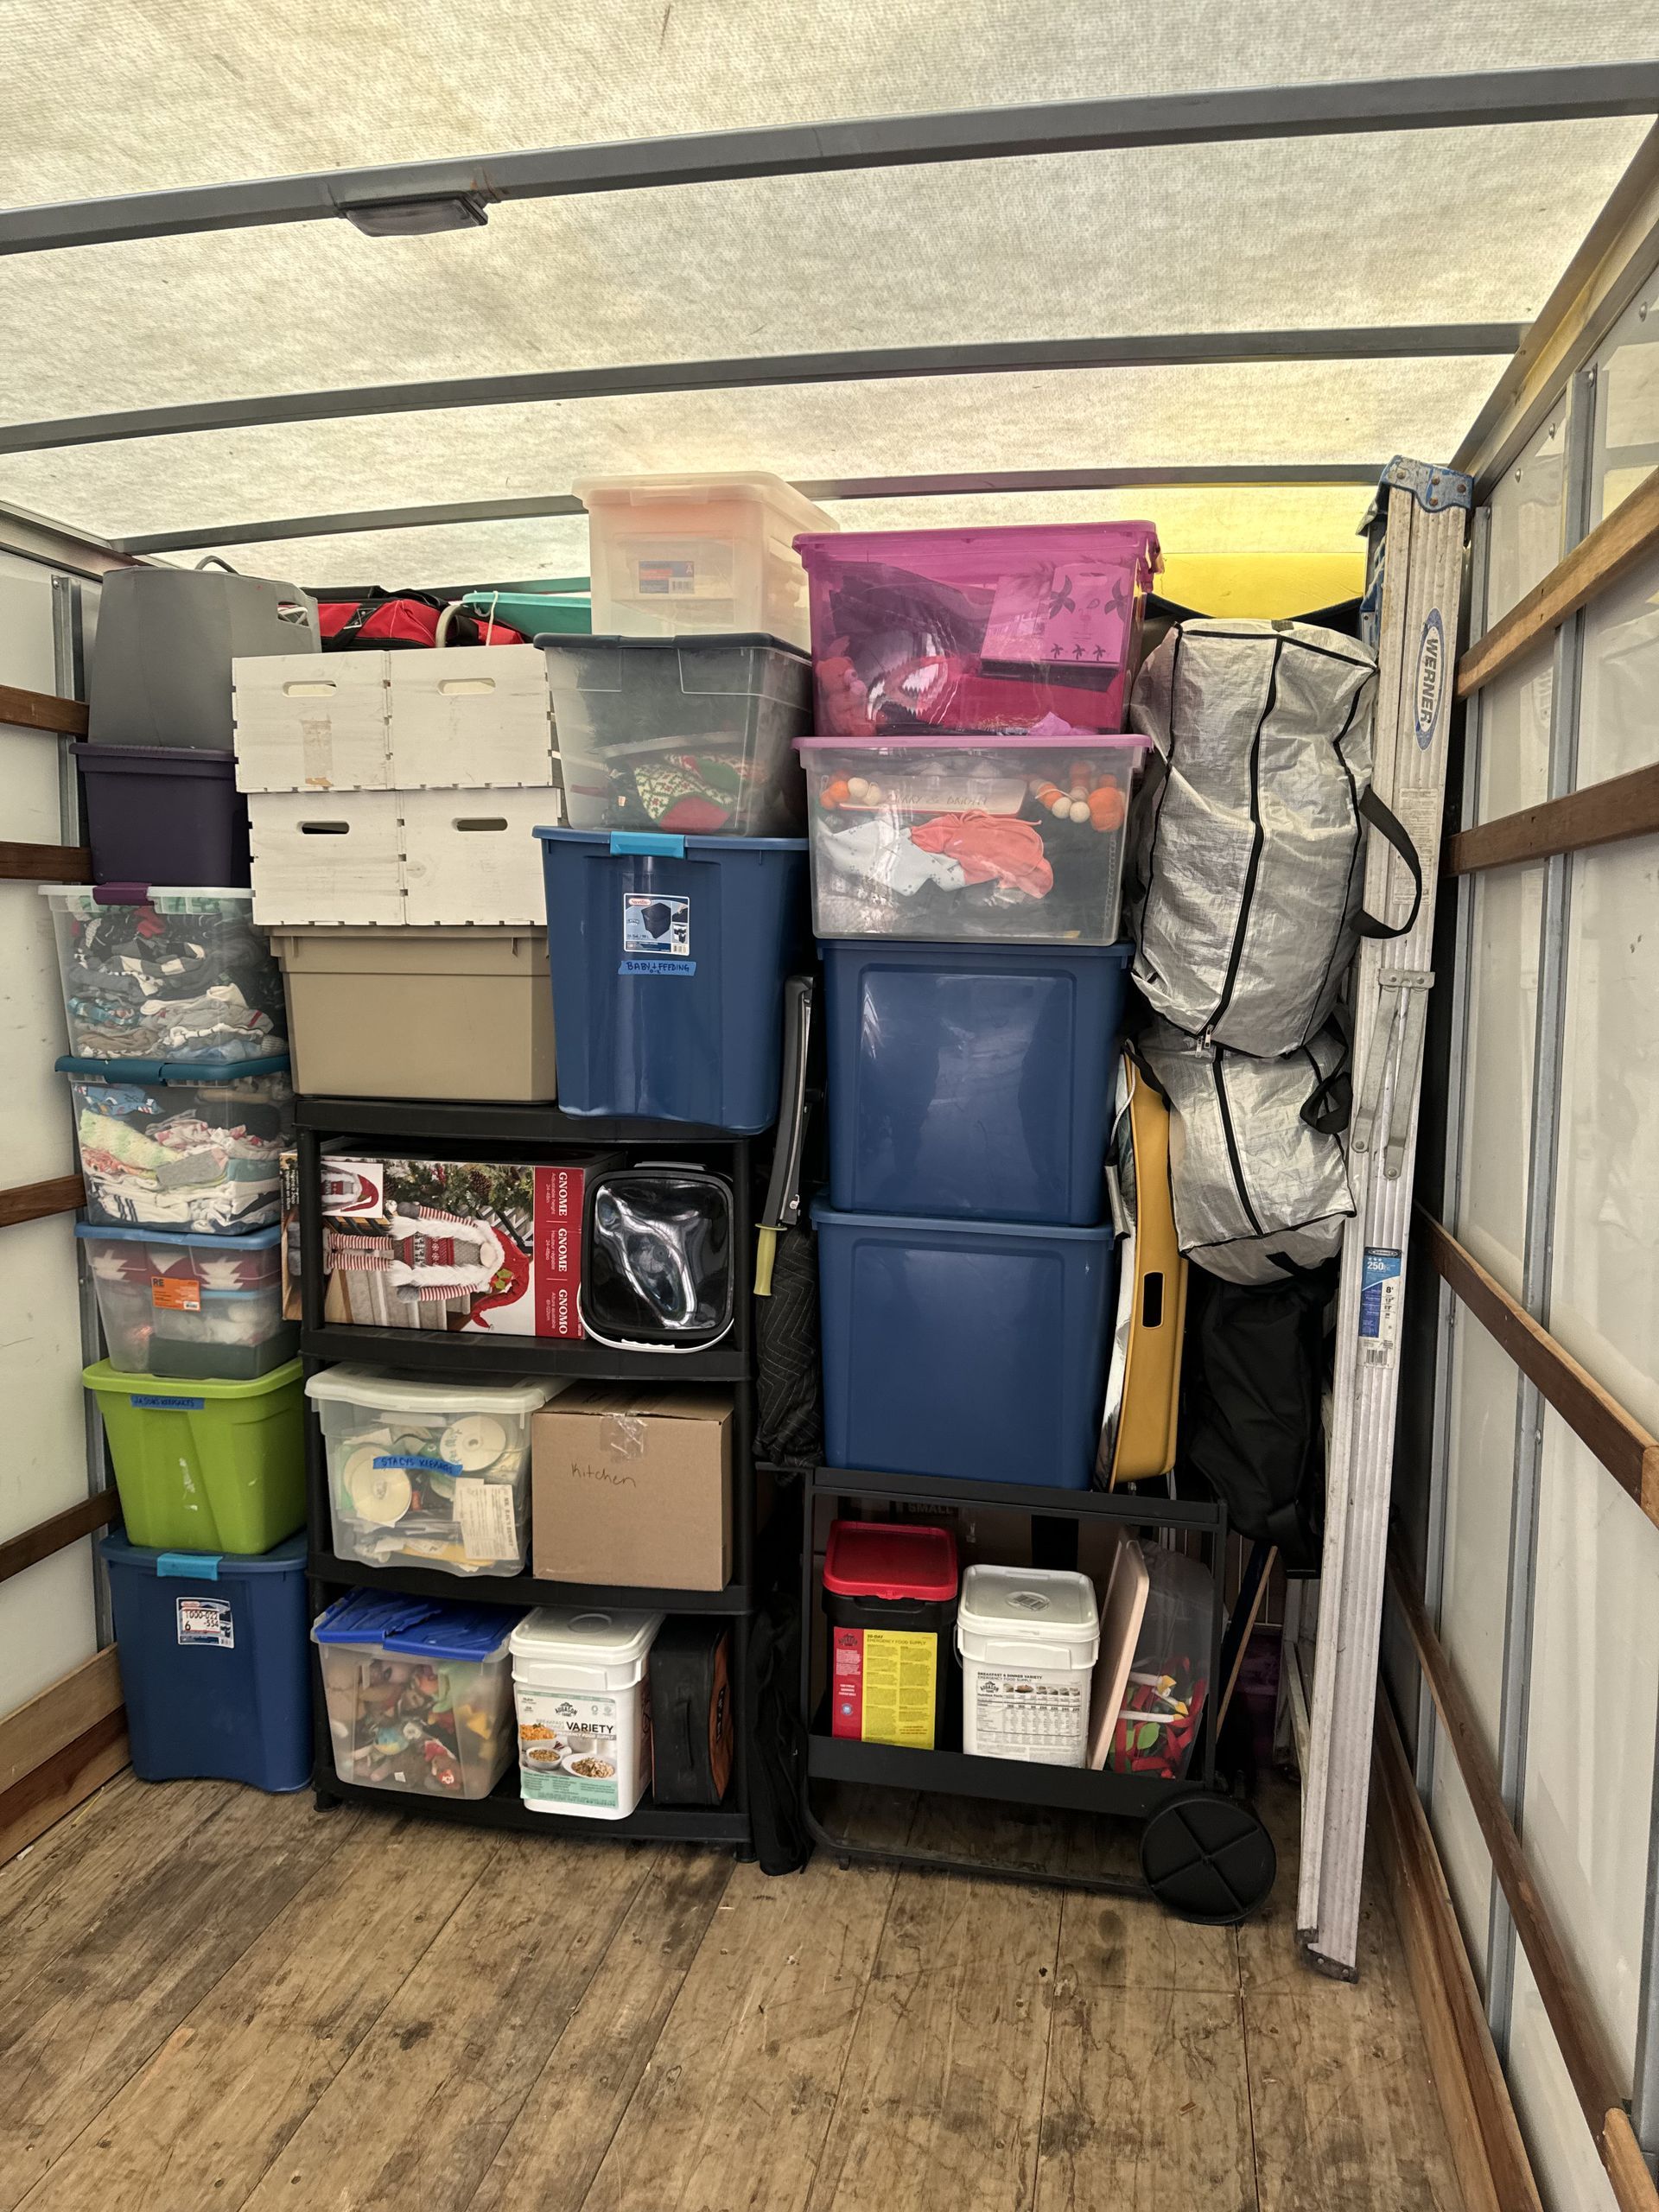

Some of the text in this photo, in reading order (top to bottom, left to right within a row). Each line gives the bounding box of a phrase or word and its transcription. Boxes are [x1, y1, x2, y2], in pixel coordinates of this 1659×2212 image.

[1421, 639, 1438, 724] WERNER
[626, 962, 650, 970] BABY
[658, 963, 690, 972] FEEDING
[558, 1172, 568, 1217] GNOME
[558, 1228, 568, 1272] GNOME
[1367, 1262, 1384, 1270] 250
[558, 1289, 569, 1335] GNOMO
[571, 1463, 636, 1488] Kitchen
[566, 1721, 613, 1734] VARIETY
